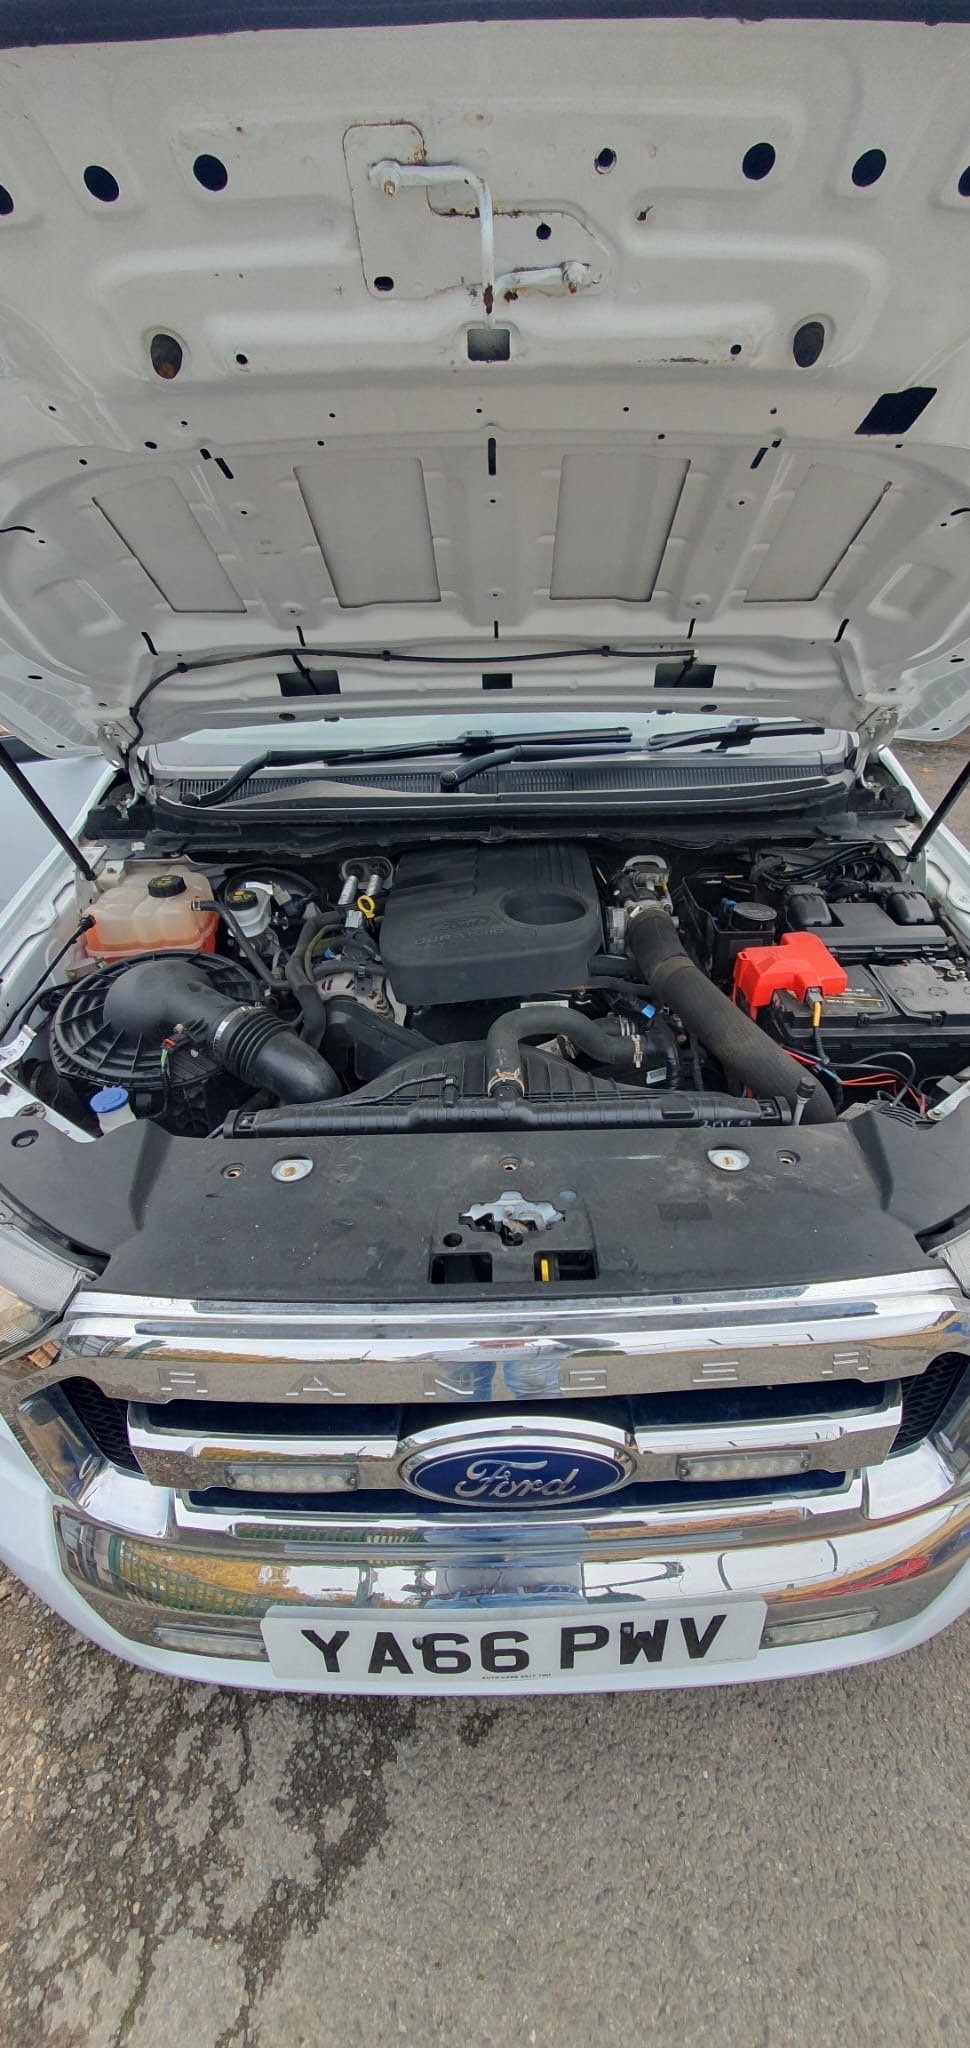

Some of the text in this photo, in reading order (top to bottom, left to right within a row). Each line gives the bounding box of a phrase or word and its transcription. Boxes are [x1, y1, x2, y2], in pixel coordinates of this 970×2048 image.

[158, 1348, 871, 1397] RANGER
[454, 1458, 580, 1498] Ford
[300, 1614, 728, 1676] YA66 PWV
